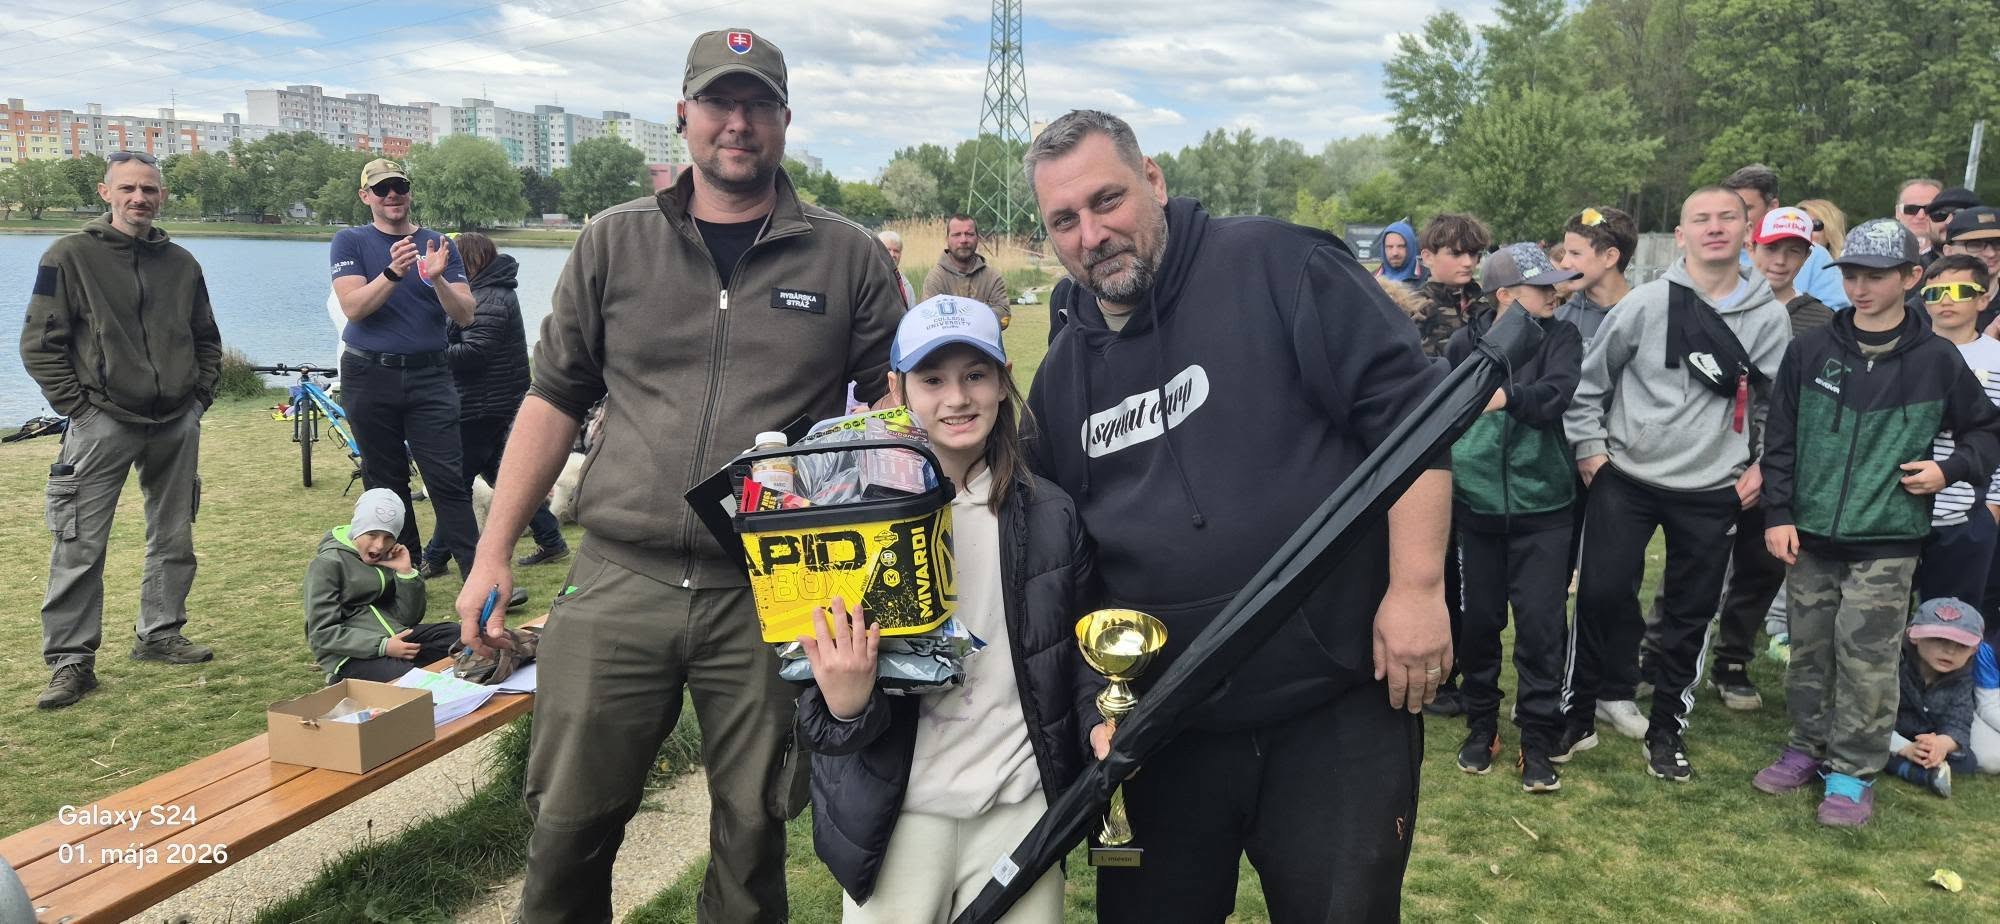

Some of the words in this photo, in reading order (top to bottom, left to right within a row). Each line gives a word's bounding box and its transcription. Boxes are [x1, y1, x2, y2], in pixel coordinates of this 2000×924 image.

[780, 292, 816, 303] RYBÁRSKA
[786, 300, 810, 308] STRÁŽ
[926, 321, 971, 330] UNIVERSITY
[1092, 398, 1147, 449] squat
[771, 561, 873, 610] BOX
[910, 526, 935, 619] MIVARDI
